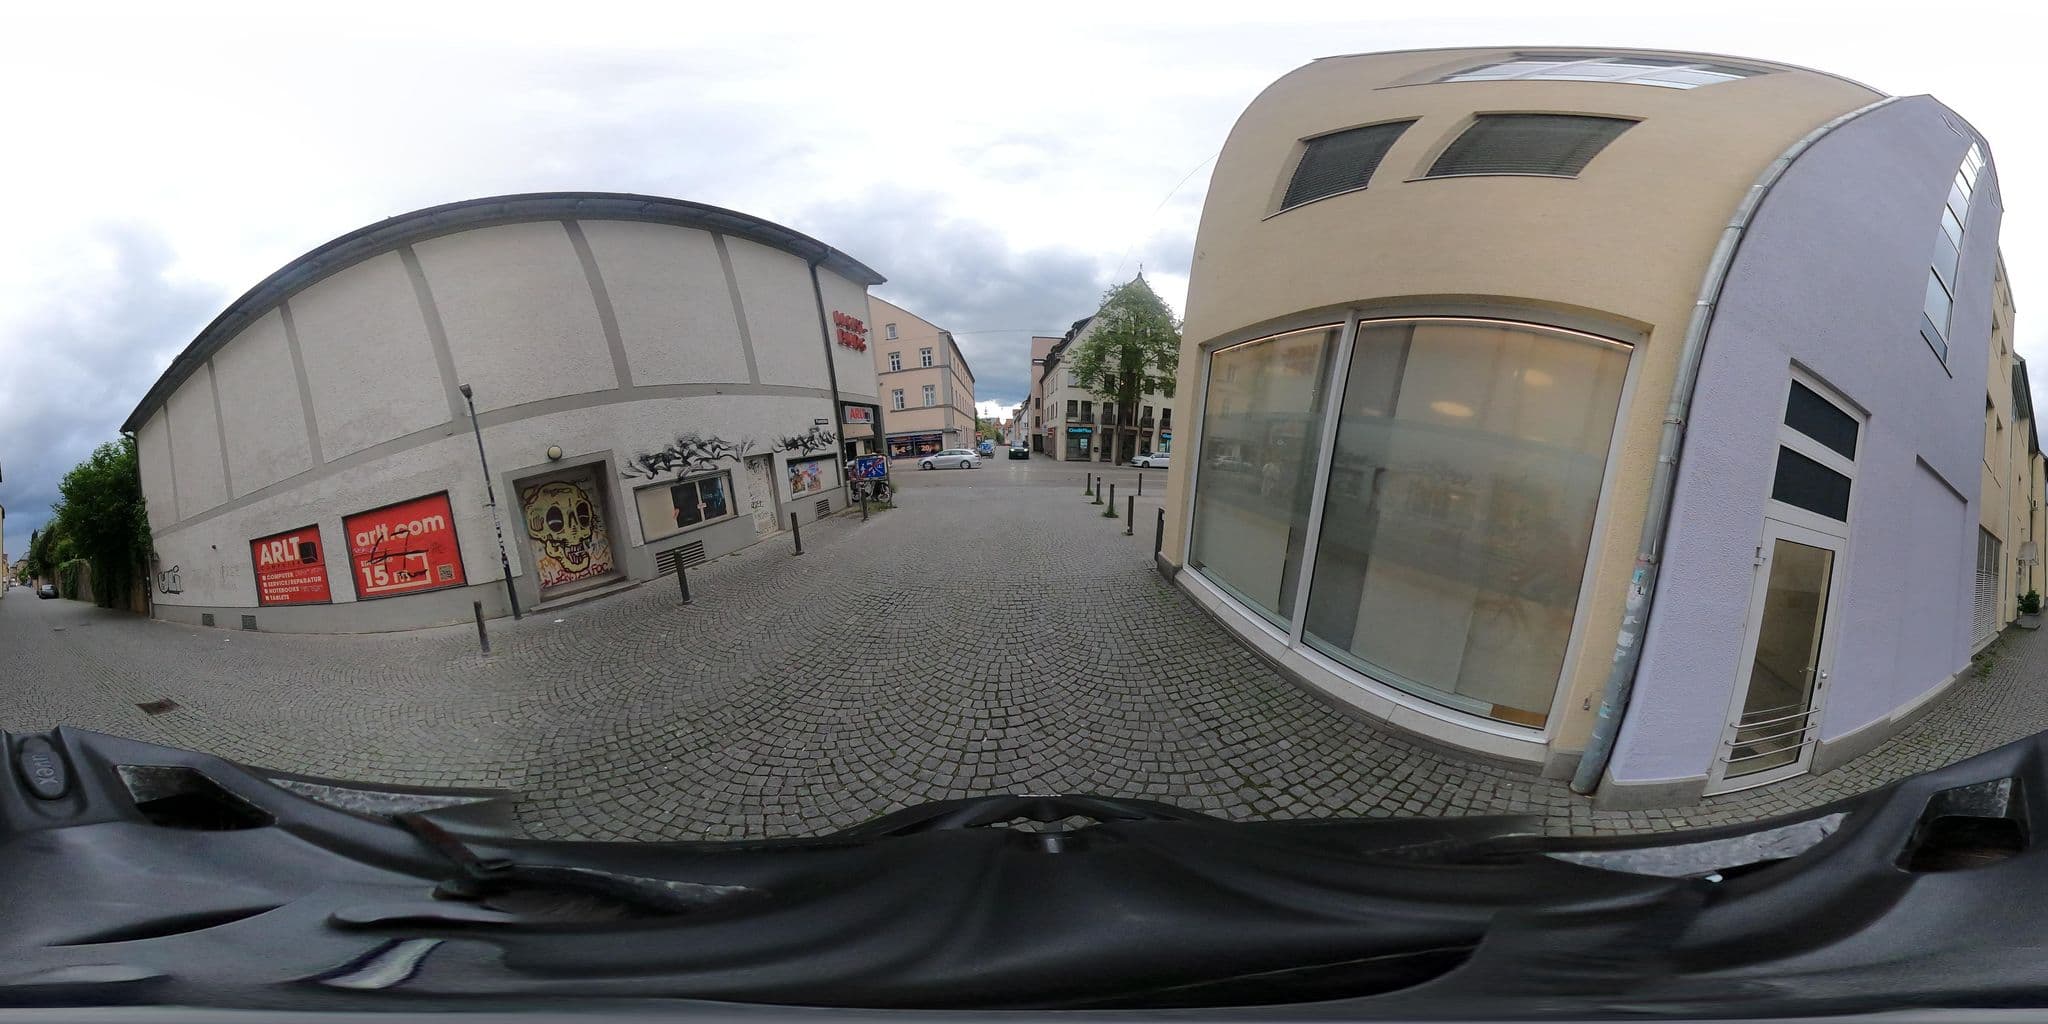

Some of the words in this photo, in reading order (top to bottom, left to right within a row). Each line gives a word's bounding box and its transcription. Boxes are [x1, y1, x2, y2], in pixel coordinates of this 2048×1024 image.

[260, 536, 301, 566] ARLT
[266, 572, 294, 580] COMPUTER
[361, 564, 389, 587] 15
[269, 586, 300, 594] NOTEBOOKS
